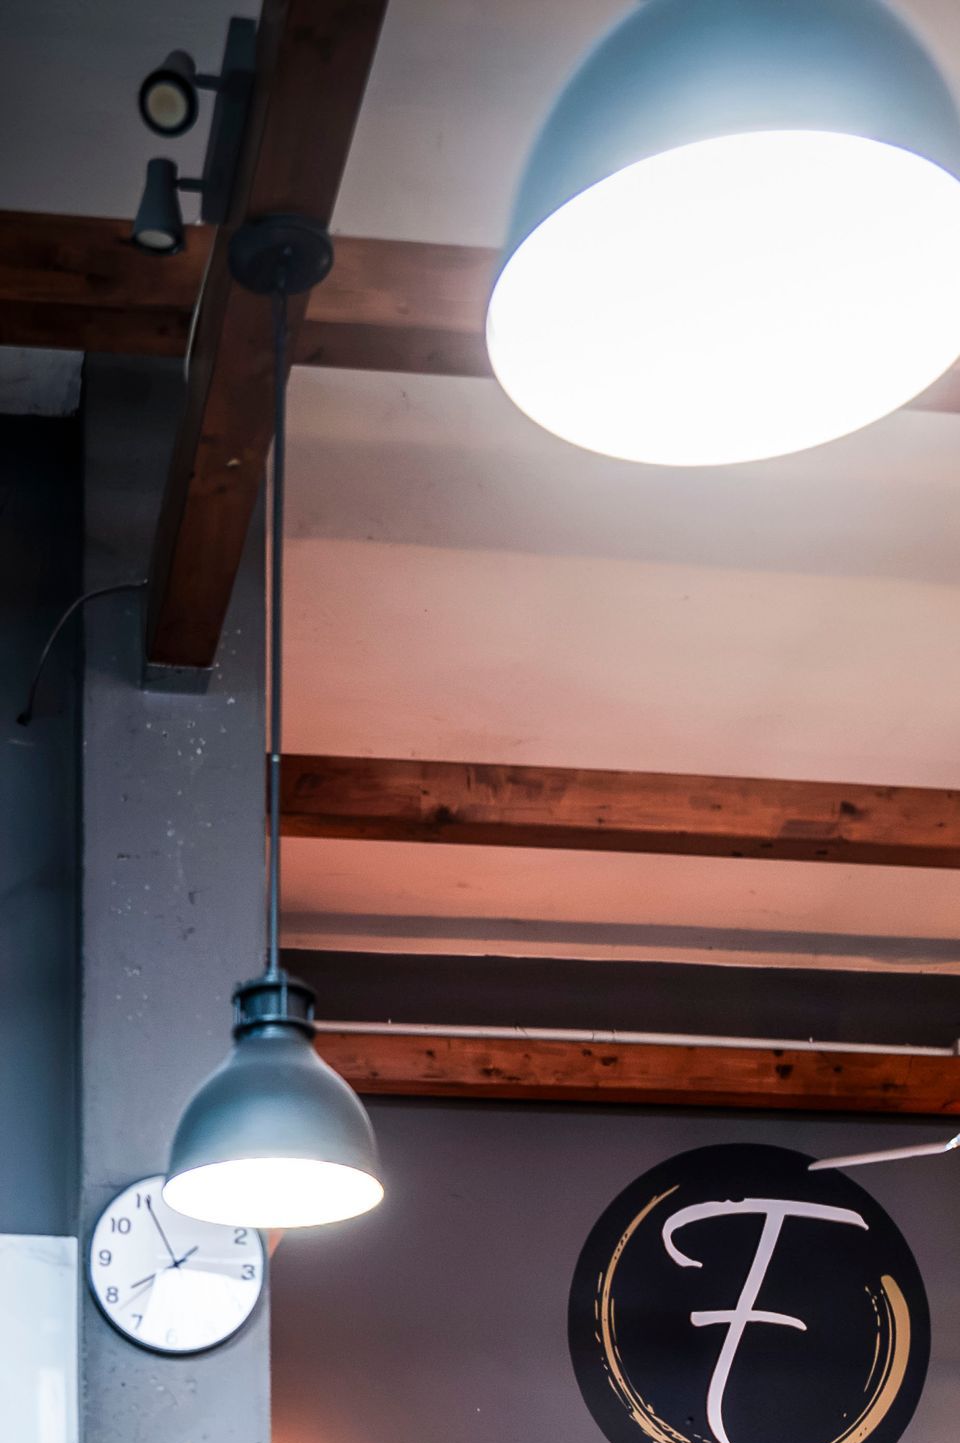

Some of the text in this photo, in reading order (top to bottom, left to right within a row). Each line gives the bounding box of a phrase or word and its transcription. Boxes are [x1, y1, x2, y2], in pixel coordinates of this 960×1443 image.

[110, 1217, 131, 1234] 10
[234, 1228, 248, 1245] 2
[98, 1249, 112, 1266] 9
[241, 1264, 255, 1280] 3
[106, 1287, 119, 1303] 8
[131, 1314, 143, 1330] 7
